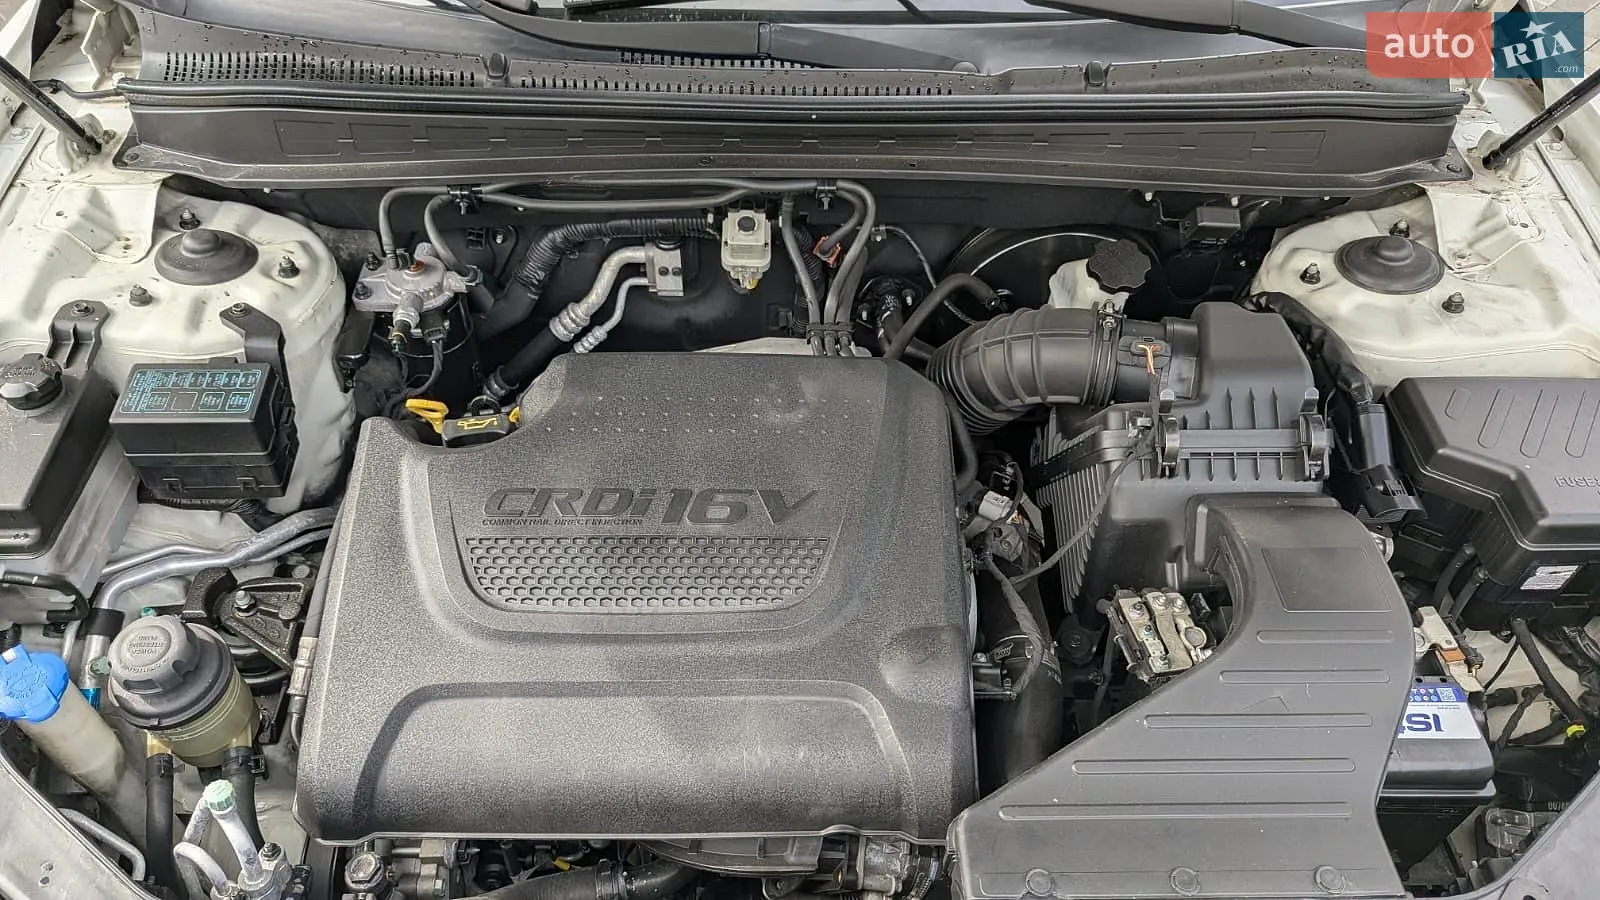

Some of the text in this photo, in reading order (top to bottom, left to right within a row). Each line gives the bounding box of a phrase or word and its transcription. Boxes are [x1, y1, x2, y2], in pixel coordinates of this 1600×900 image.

[482, 518, 527, 526] COMMON
[553, 518, 588, 526] DIRECT
[591, 518, 643, 526] INJECTION
